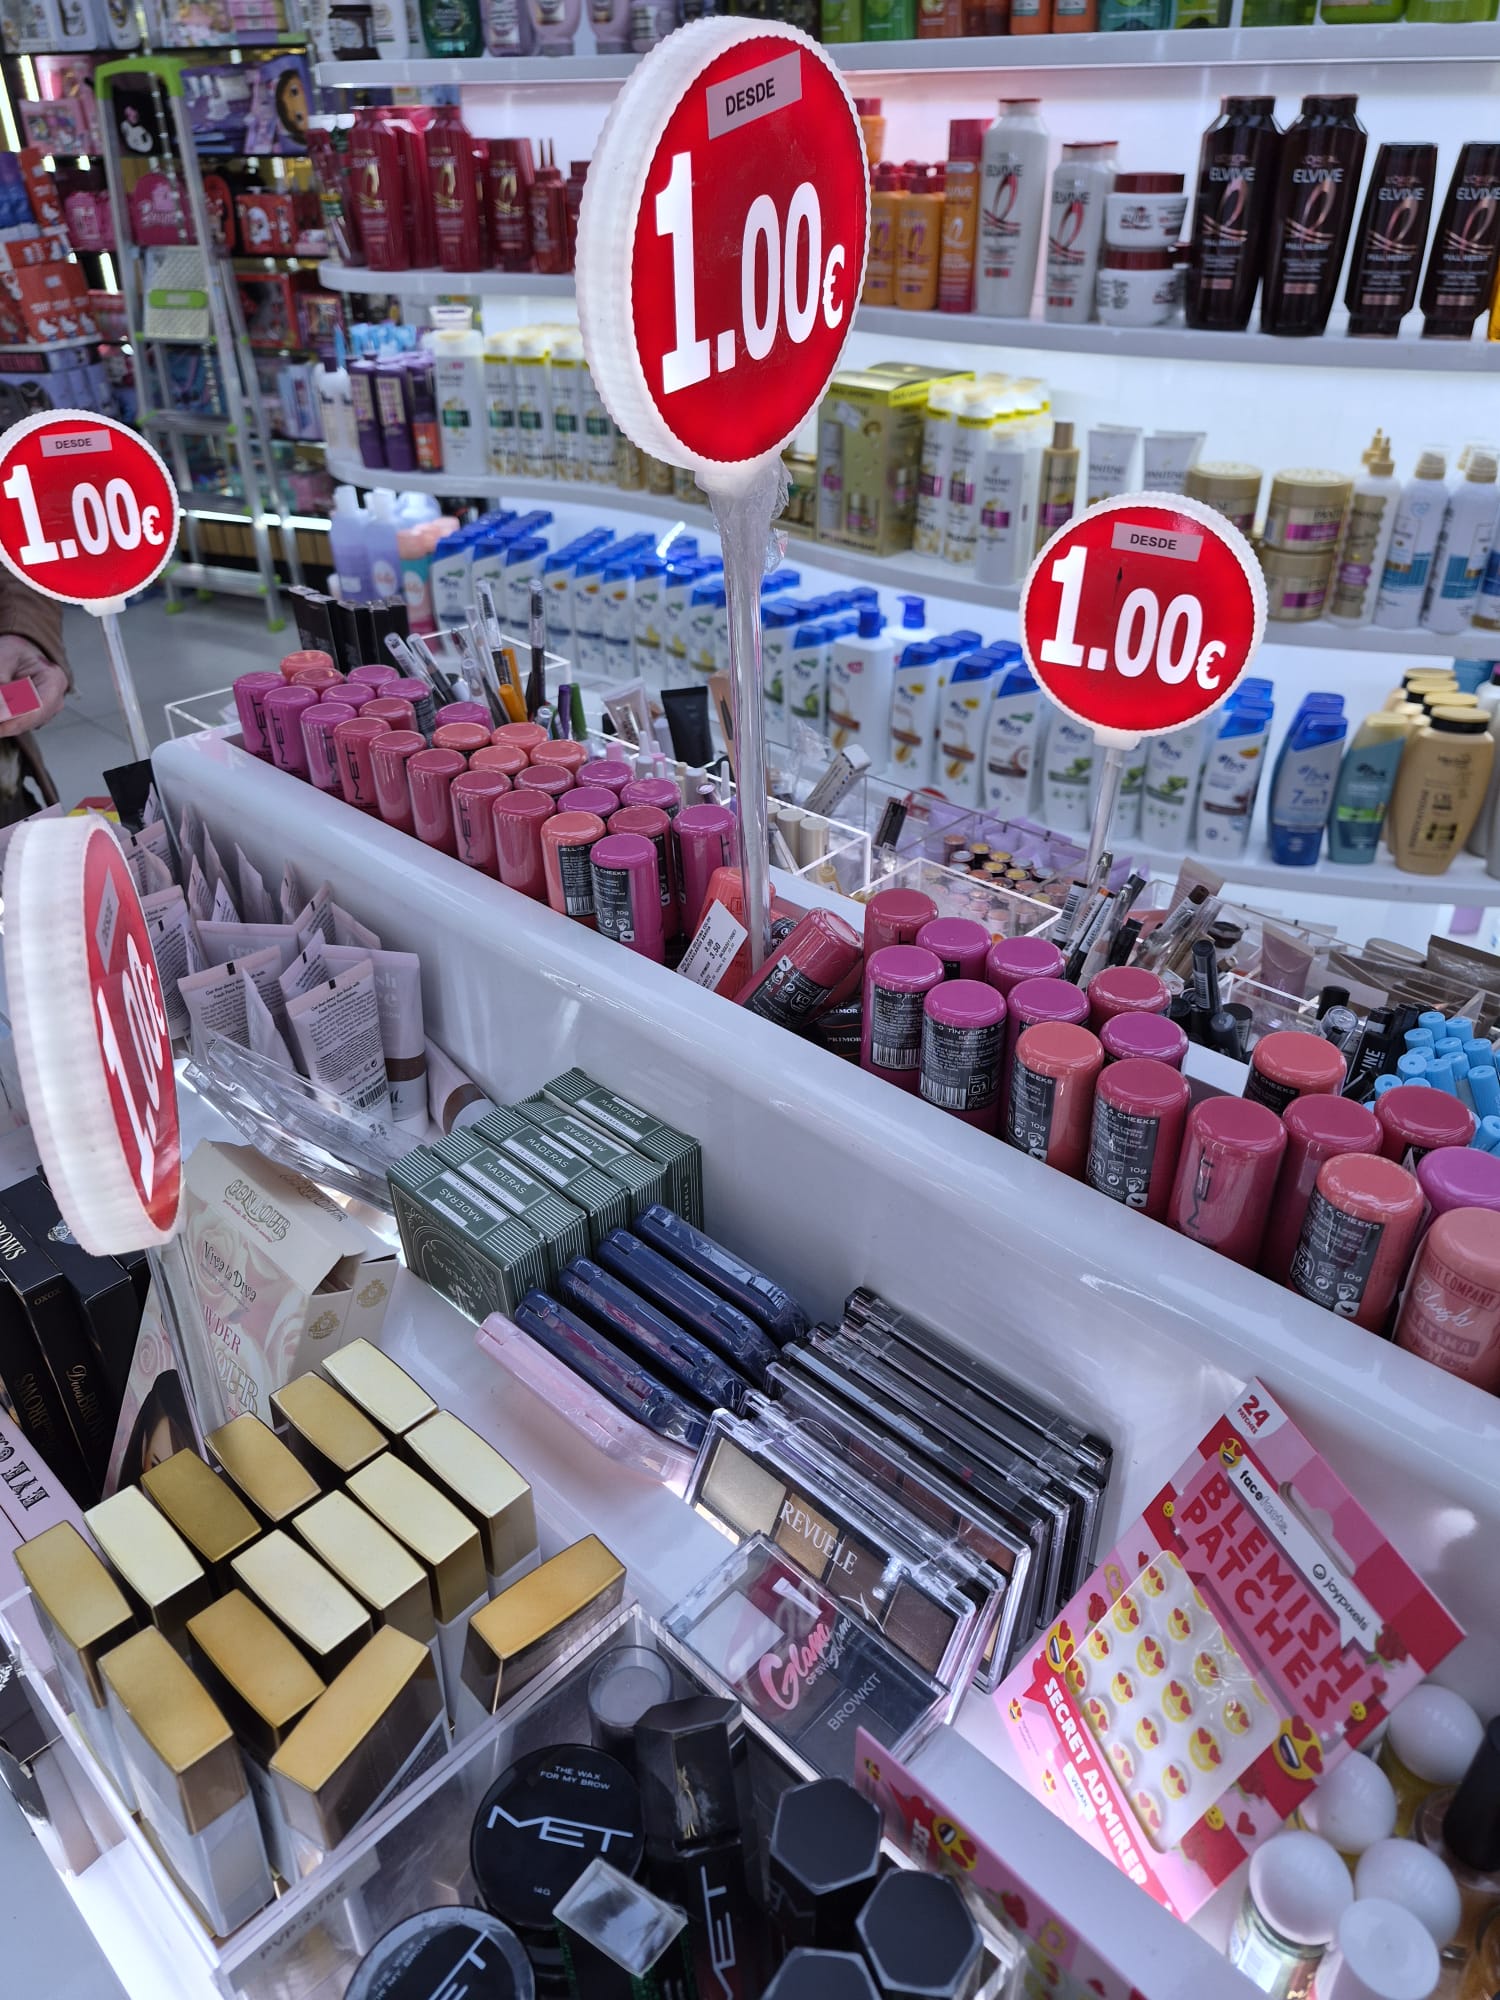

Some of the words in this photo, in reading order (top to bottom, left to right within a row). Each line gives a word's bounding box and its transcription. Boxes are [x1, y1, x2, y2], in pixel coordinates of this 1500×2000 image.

[725, 78, 776, 117] DESDE
[1209, 167, 1256, 182] ELVIVE
[1293, 168, 1344, 183] ELVIVE
[1378, 187, 1425, 201] ELVIVE
[655, 151, 845, 395] 1.00€
[55, 437, 92, 449] DESDE
[3, 464, 165, 566] 1.00€
[1130, 533, 1177, 550] DESDE
[1040, 545, 1227, 690] 1.00€
[250, 695, 271, 749] MET
[270, 708, 289, 764] MET
[345, 743, 364, 800] MET
[460, 799, 476, 860] MET
[708, 942, 722, 959] 3,50
[1022, 1069, 1053, 1085] CHEEKS
[1260, 1076, 1299, 1095] CHEEKS
[602, 1098, 642, 1127] MADERAS
[1030, 1121, 1046, 1132] 10g
[1117, 1112, 1156, 1125] CHEEKS
[527, 1137, 569, 1168] MADERAS
[564, 1124, 608, 1153] MADERAS
[483, 1162, 527, 1194] MADERAS
[1129, 1166, 1147, 1174] 10g
[440, 1188, 483, 1223] MADERAS
[1336, 1211, 1380, 1230] CHEEKS
[1343, 1271, 1363, 1283] 10g
[1443, 1270, 1496, 1308] COMPANY
[1414, 1279, 1475, 1328] Blush
[1237, 1407, 1258, 1436] PATCHES
[1242, 1394, 1270, 1428] 24
[1, 1460, 50, 1512] EYE
[780, 1500, 858, 1576] REVUELE
[1199, 1471, 1365, 1694] BLEMISH
[1181, 1496, 1337, 1719] PATCHES
[758, 1623, 831, 1711] Glam
[805, 1672, 819, 1686] OF
[827, 1672, 881, 1731] BROWKIT
[540, 1770, 560, 1781] FOR
[562, 1774, 577, 1784] MY
[580, 1777, 610, 1790] BROW
[555, 1765, 574, 1774] THE
[577, 1769, 601, 1780] WAX
[1043, 1676, 1091, 1764] SECRET
[1083, 1768, 1148, 1885] ADMIRER
[1071, 1775, 1088, 1809] VEGAN
[487, 1805, 634, 1853] MET
[401, 1935, 433, 1968] BROW
